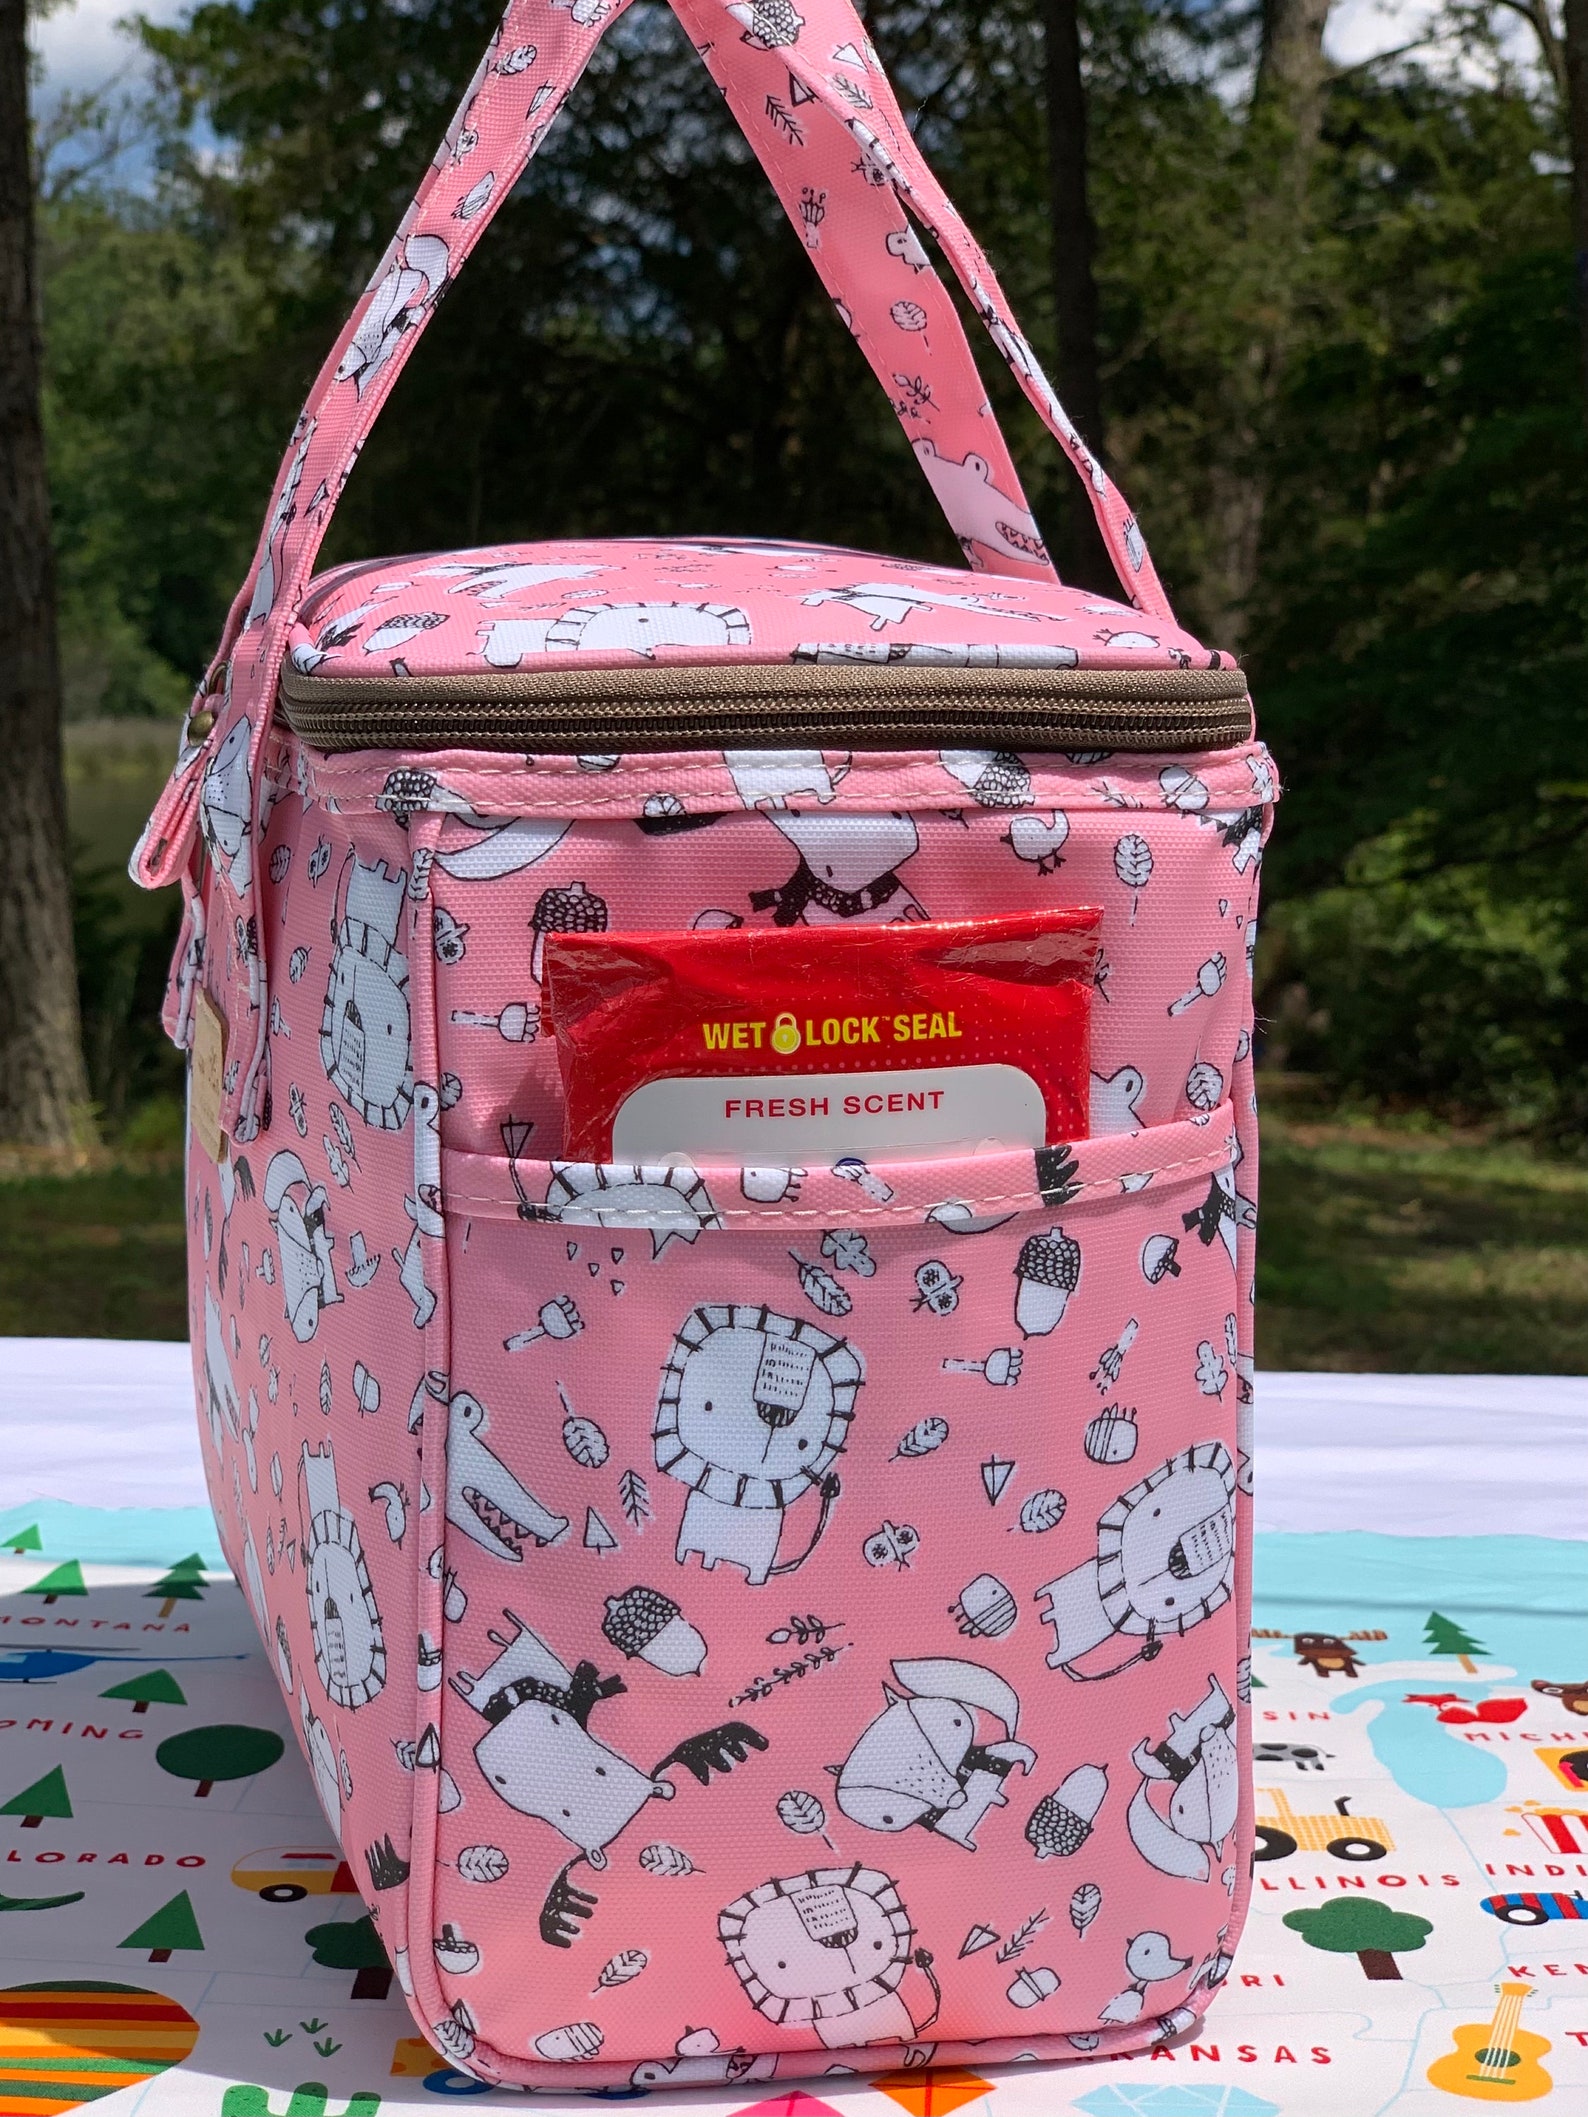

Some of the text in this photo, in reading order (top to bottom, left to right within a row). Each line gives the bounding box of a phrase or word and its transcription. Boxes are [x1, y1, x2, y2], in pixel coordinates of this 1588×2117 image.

[703, 1022, 766, 1049] WET
[893, 1011, 963, 1042] SEAL
[725, 1091, 945, 1118] FRESH SCENT
[6, 1849, 206, 1868] LORADO
[1222, 1974, 1285, 1987] RI
